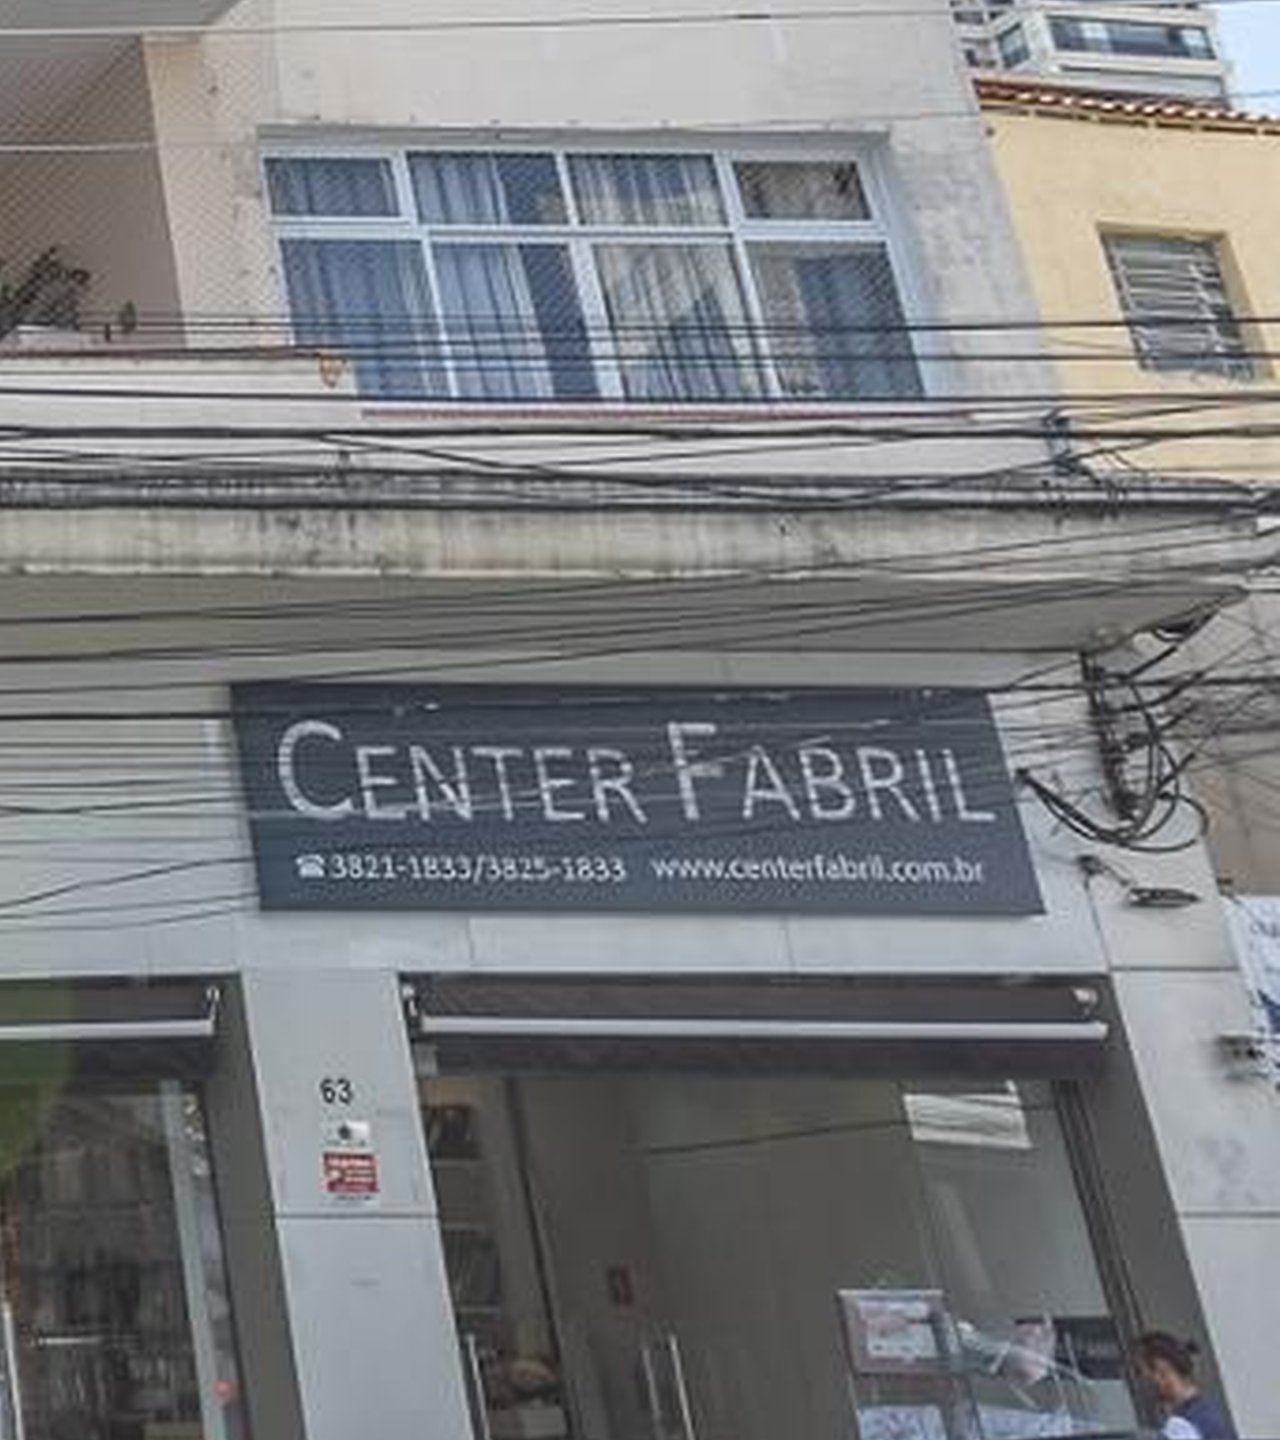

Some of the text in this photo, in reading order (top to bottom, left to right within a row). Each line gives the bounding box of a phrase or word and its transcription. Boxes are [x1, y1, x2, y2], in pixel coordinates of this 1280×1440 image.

[277, 719, 996, 823] CENTER FABRIL
[651, 854, 985, 884] www.centerfabril.com.br
[320, 1077, 354, 1106] 63
